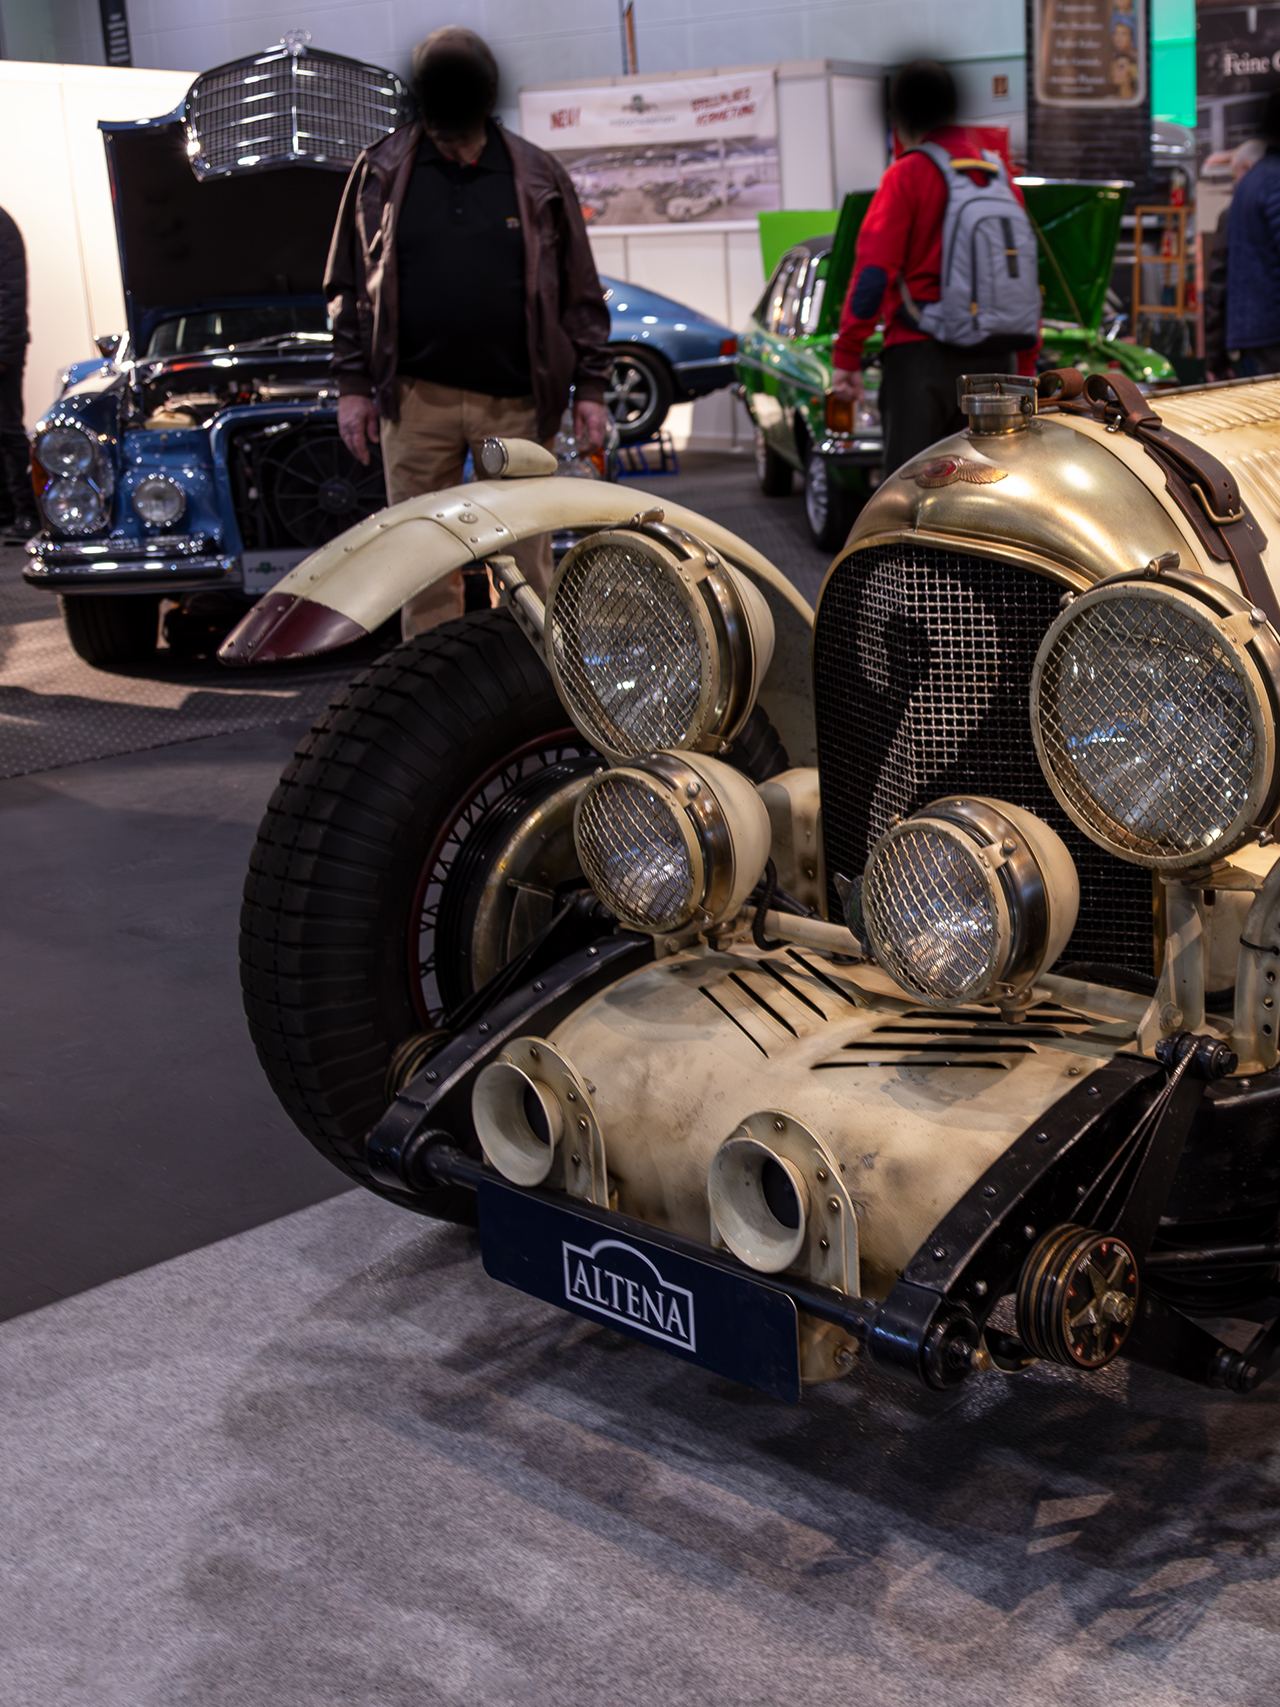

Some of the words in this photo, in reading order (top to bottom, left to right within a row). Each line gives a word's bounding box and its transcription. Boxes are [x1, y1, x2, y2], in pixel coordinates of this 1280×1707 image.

[1222, 52, 1270, 76] Feine
[550, 106, 581, 131] NEU!
[571, 1258, 689, 1340] ALTENA
